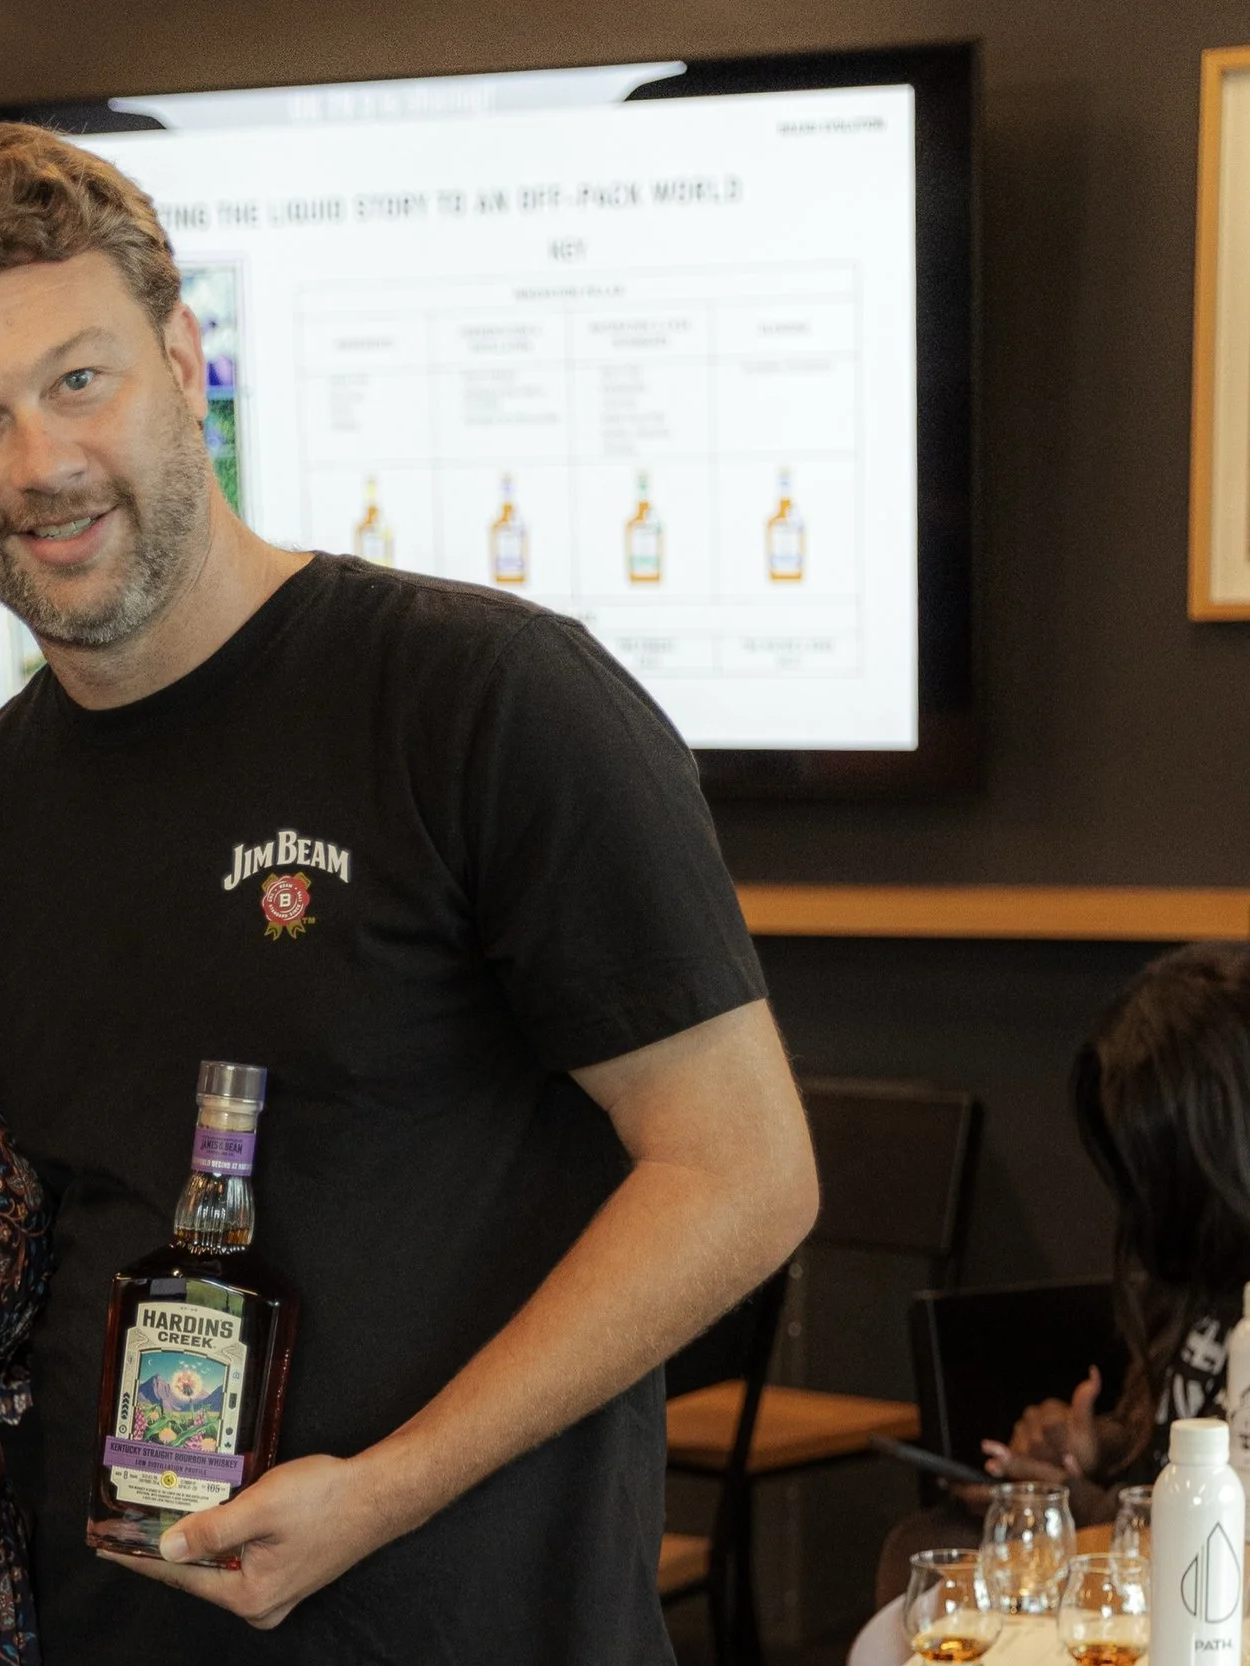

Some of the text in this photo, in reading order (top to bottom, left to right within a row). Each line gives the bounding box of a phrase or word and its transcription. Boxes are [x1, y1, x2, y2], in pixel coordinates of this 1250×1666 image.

[224, 830, 350, 891] JIM BEAM
[280, 893, 291, 907] B
[157, 1330, 213, 1349] CREEK
[110, 1441, 238, 1469] KENTUCKY STRAIGHT BOURBON WHISKEY
